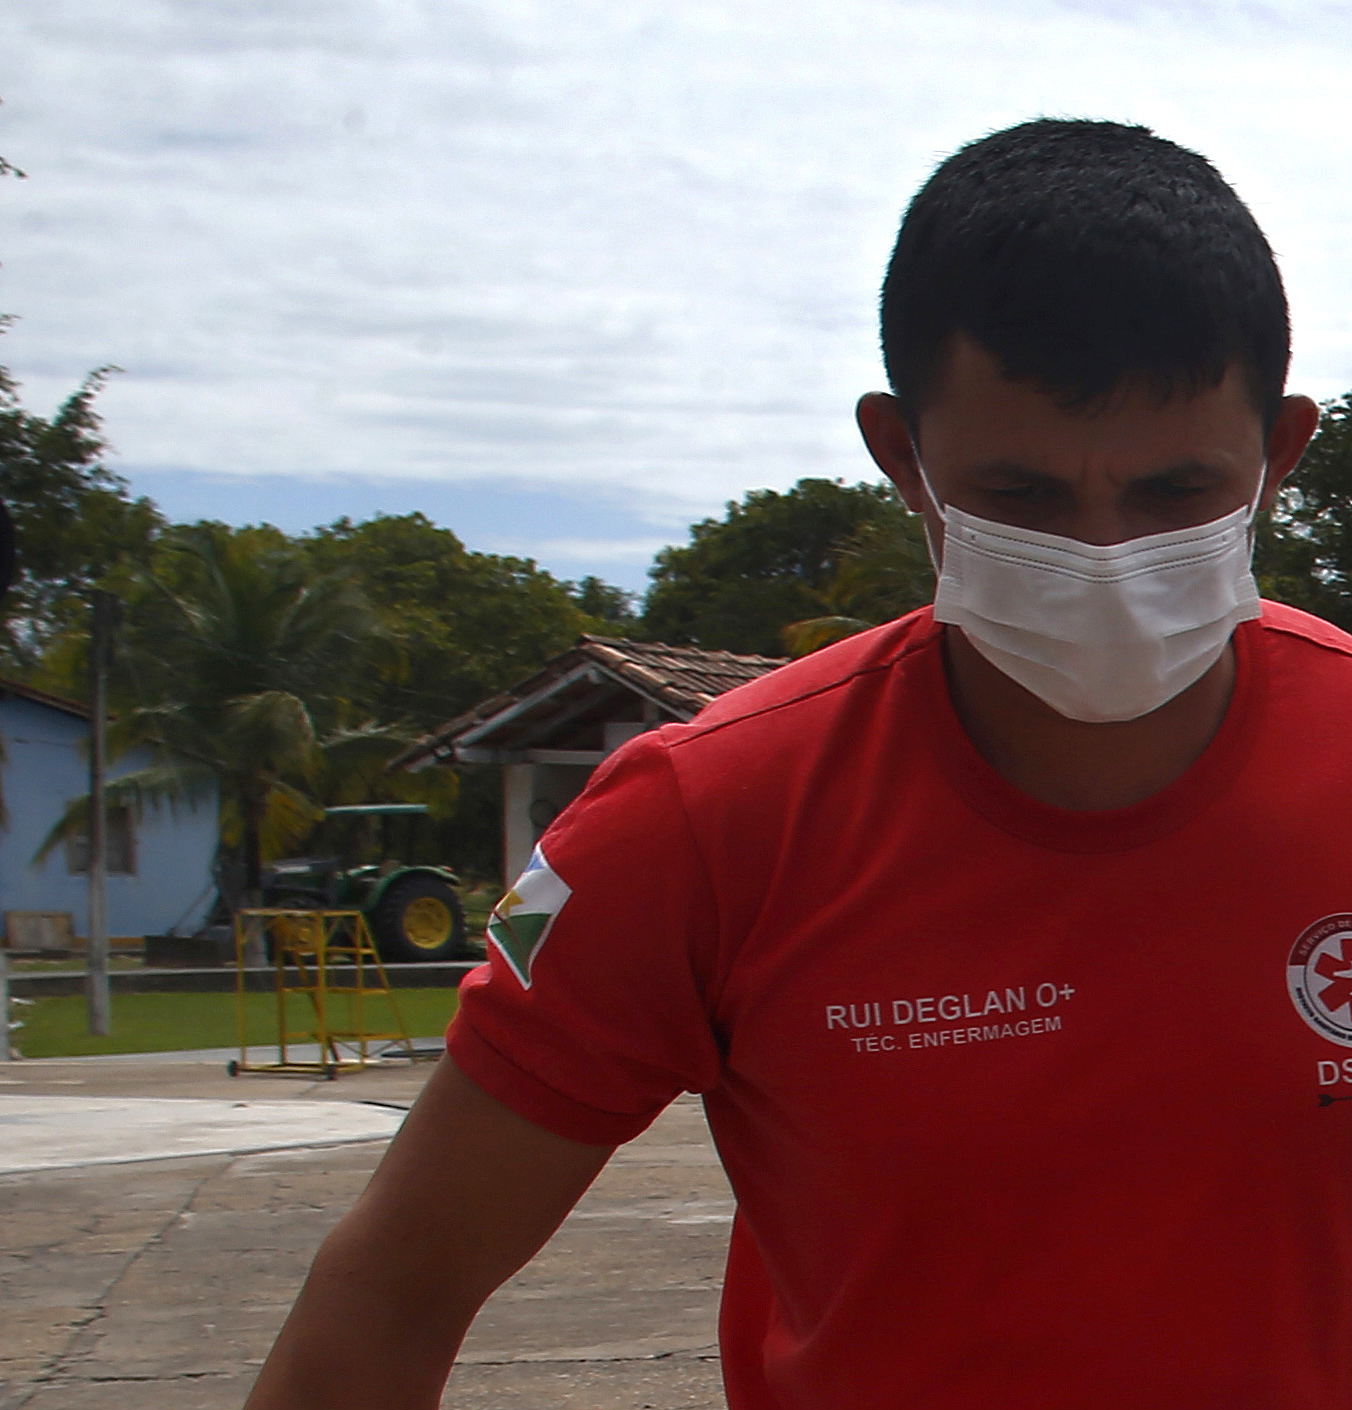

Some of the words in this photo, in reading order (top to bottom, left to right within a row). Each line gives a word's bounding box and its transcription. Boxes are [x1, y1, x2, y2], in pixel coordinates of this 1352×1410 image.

[826, 1002, 882, 1030] RUI
[892, 986, 1026, 1025] DEGLAN
[851, 1033, 902, 1053] TÉC.
[908, 1016, 1062, 1049] ENFERMAGEM
